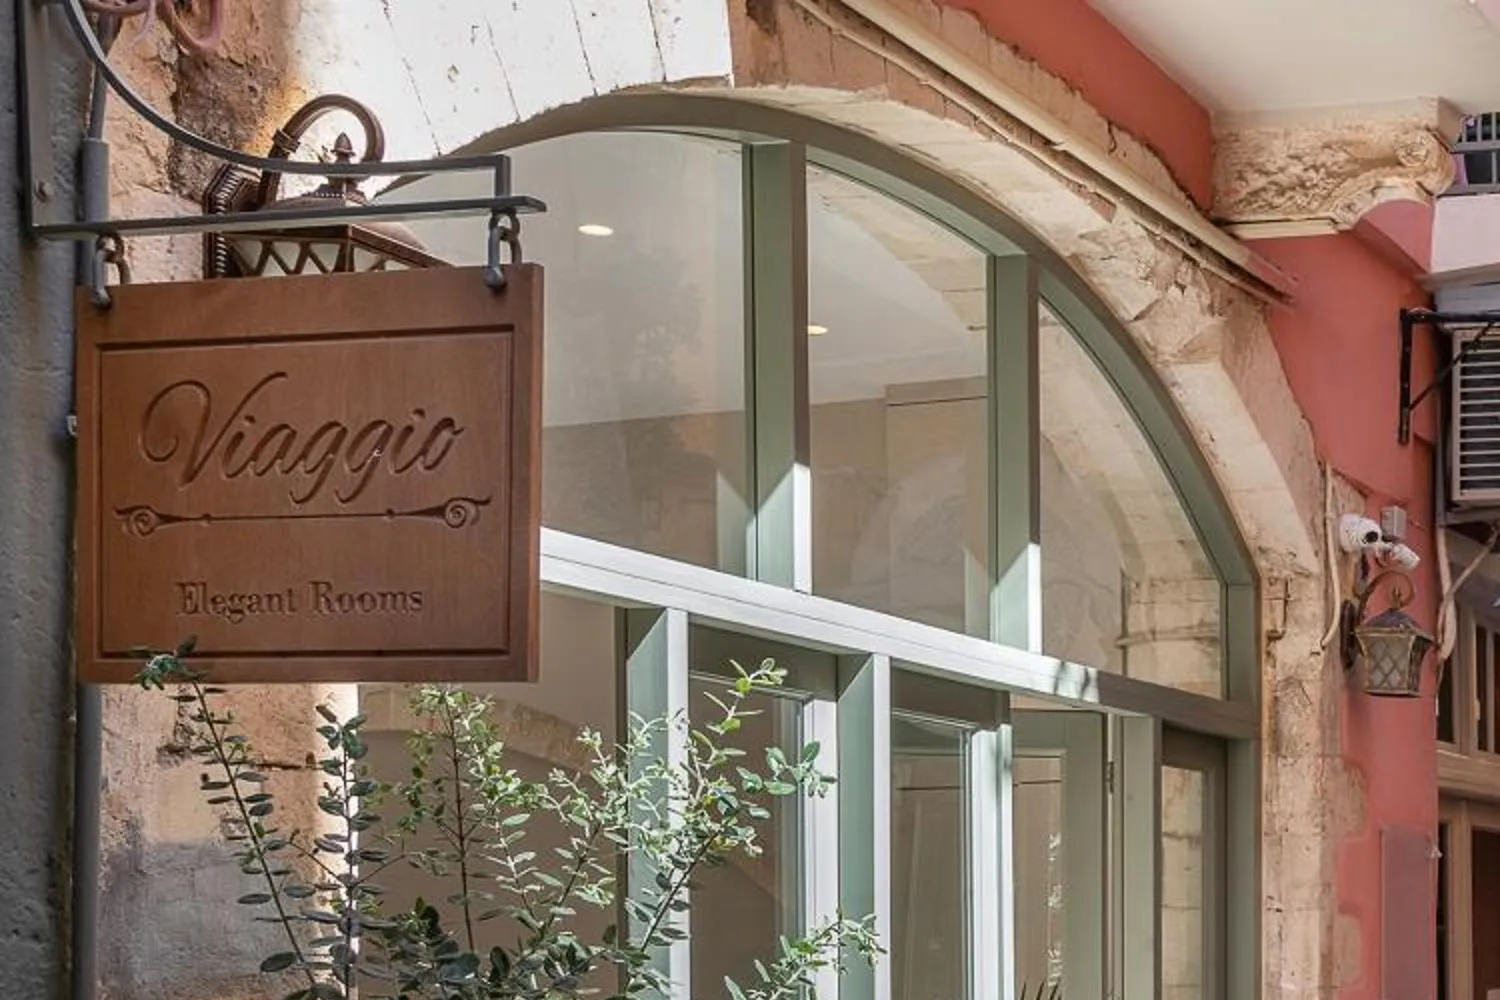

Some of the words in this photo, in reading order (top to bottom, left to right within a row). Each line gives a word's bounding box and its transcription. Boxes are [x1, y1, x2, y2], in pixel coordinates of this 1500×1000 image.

[138, 371, 466, 505] Viaggio
[176, 580, 297, 623] Elegant
[308, 579, 424, 616] Rooms
